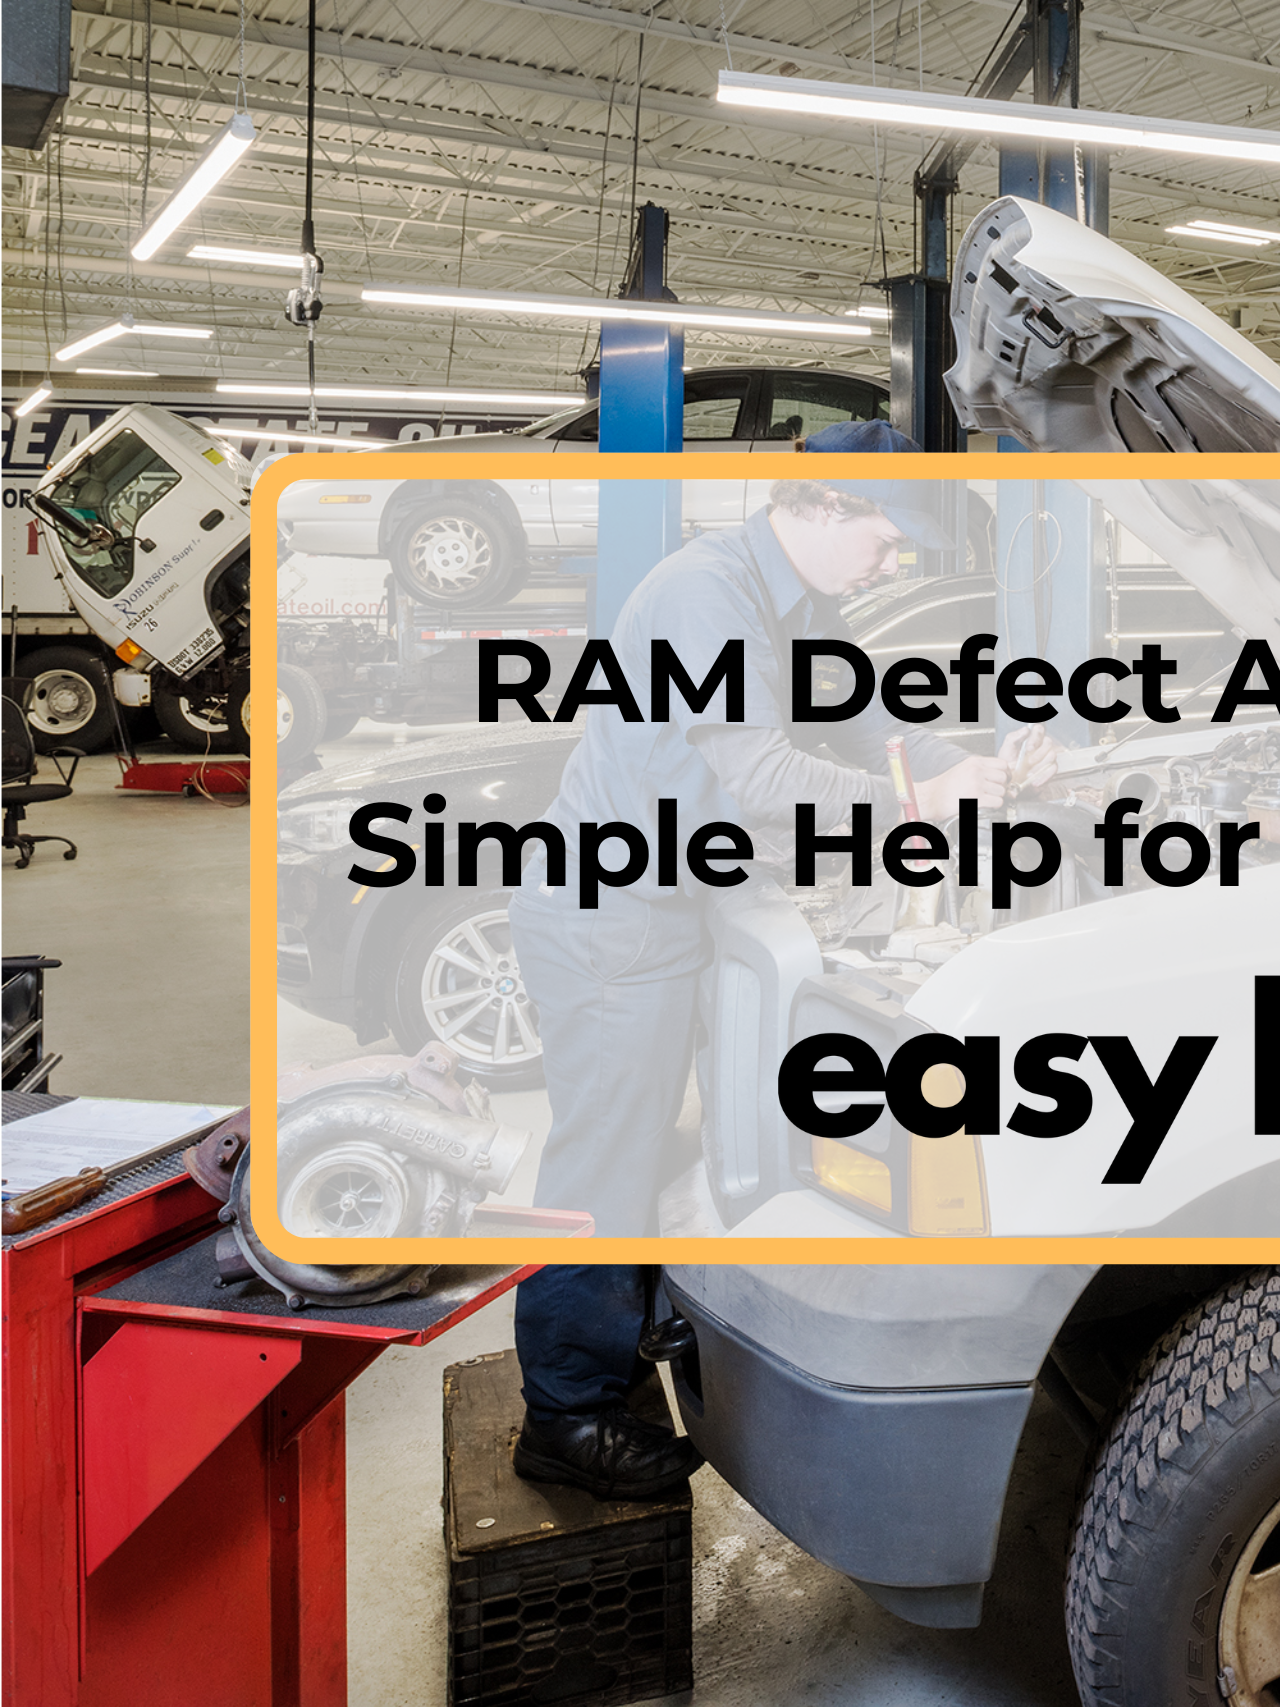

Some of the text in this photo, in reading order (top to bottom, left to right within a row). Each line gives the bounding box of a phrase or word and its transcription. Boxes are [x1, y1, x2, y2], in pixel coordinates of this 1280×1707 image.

[126, 604, 154, 630] ISUZU
[143, 618, 158, 632] 26
[377, 1117, 467, 1159] GARRETT
